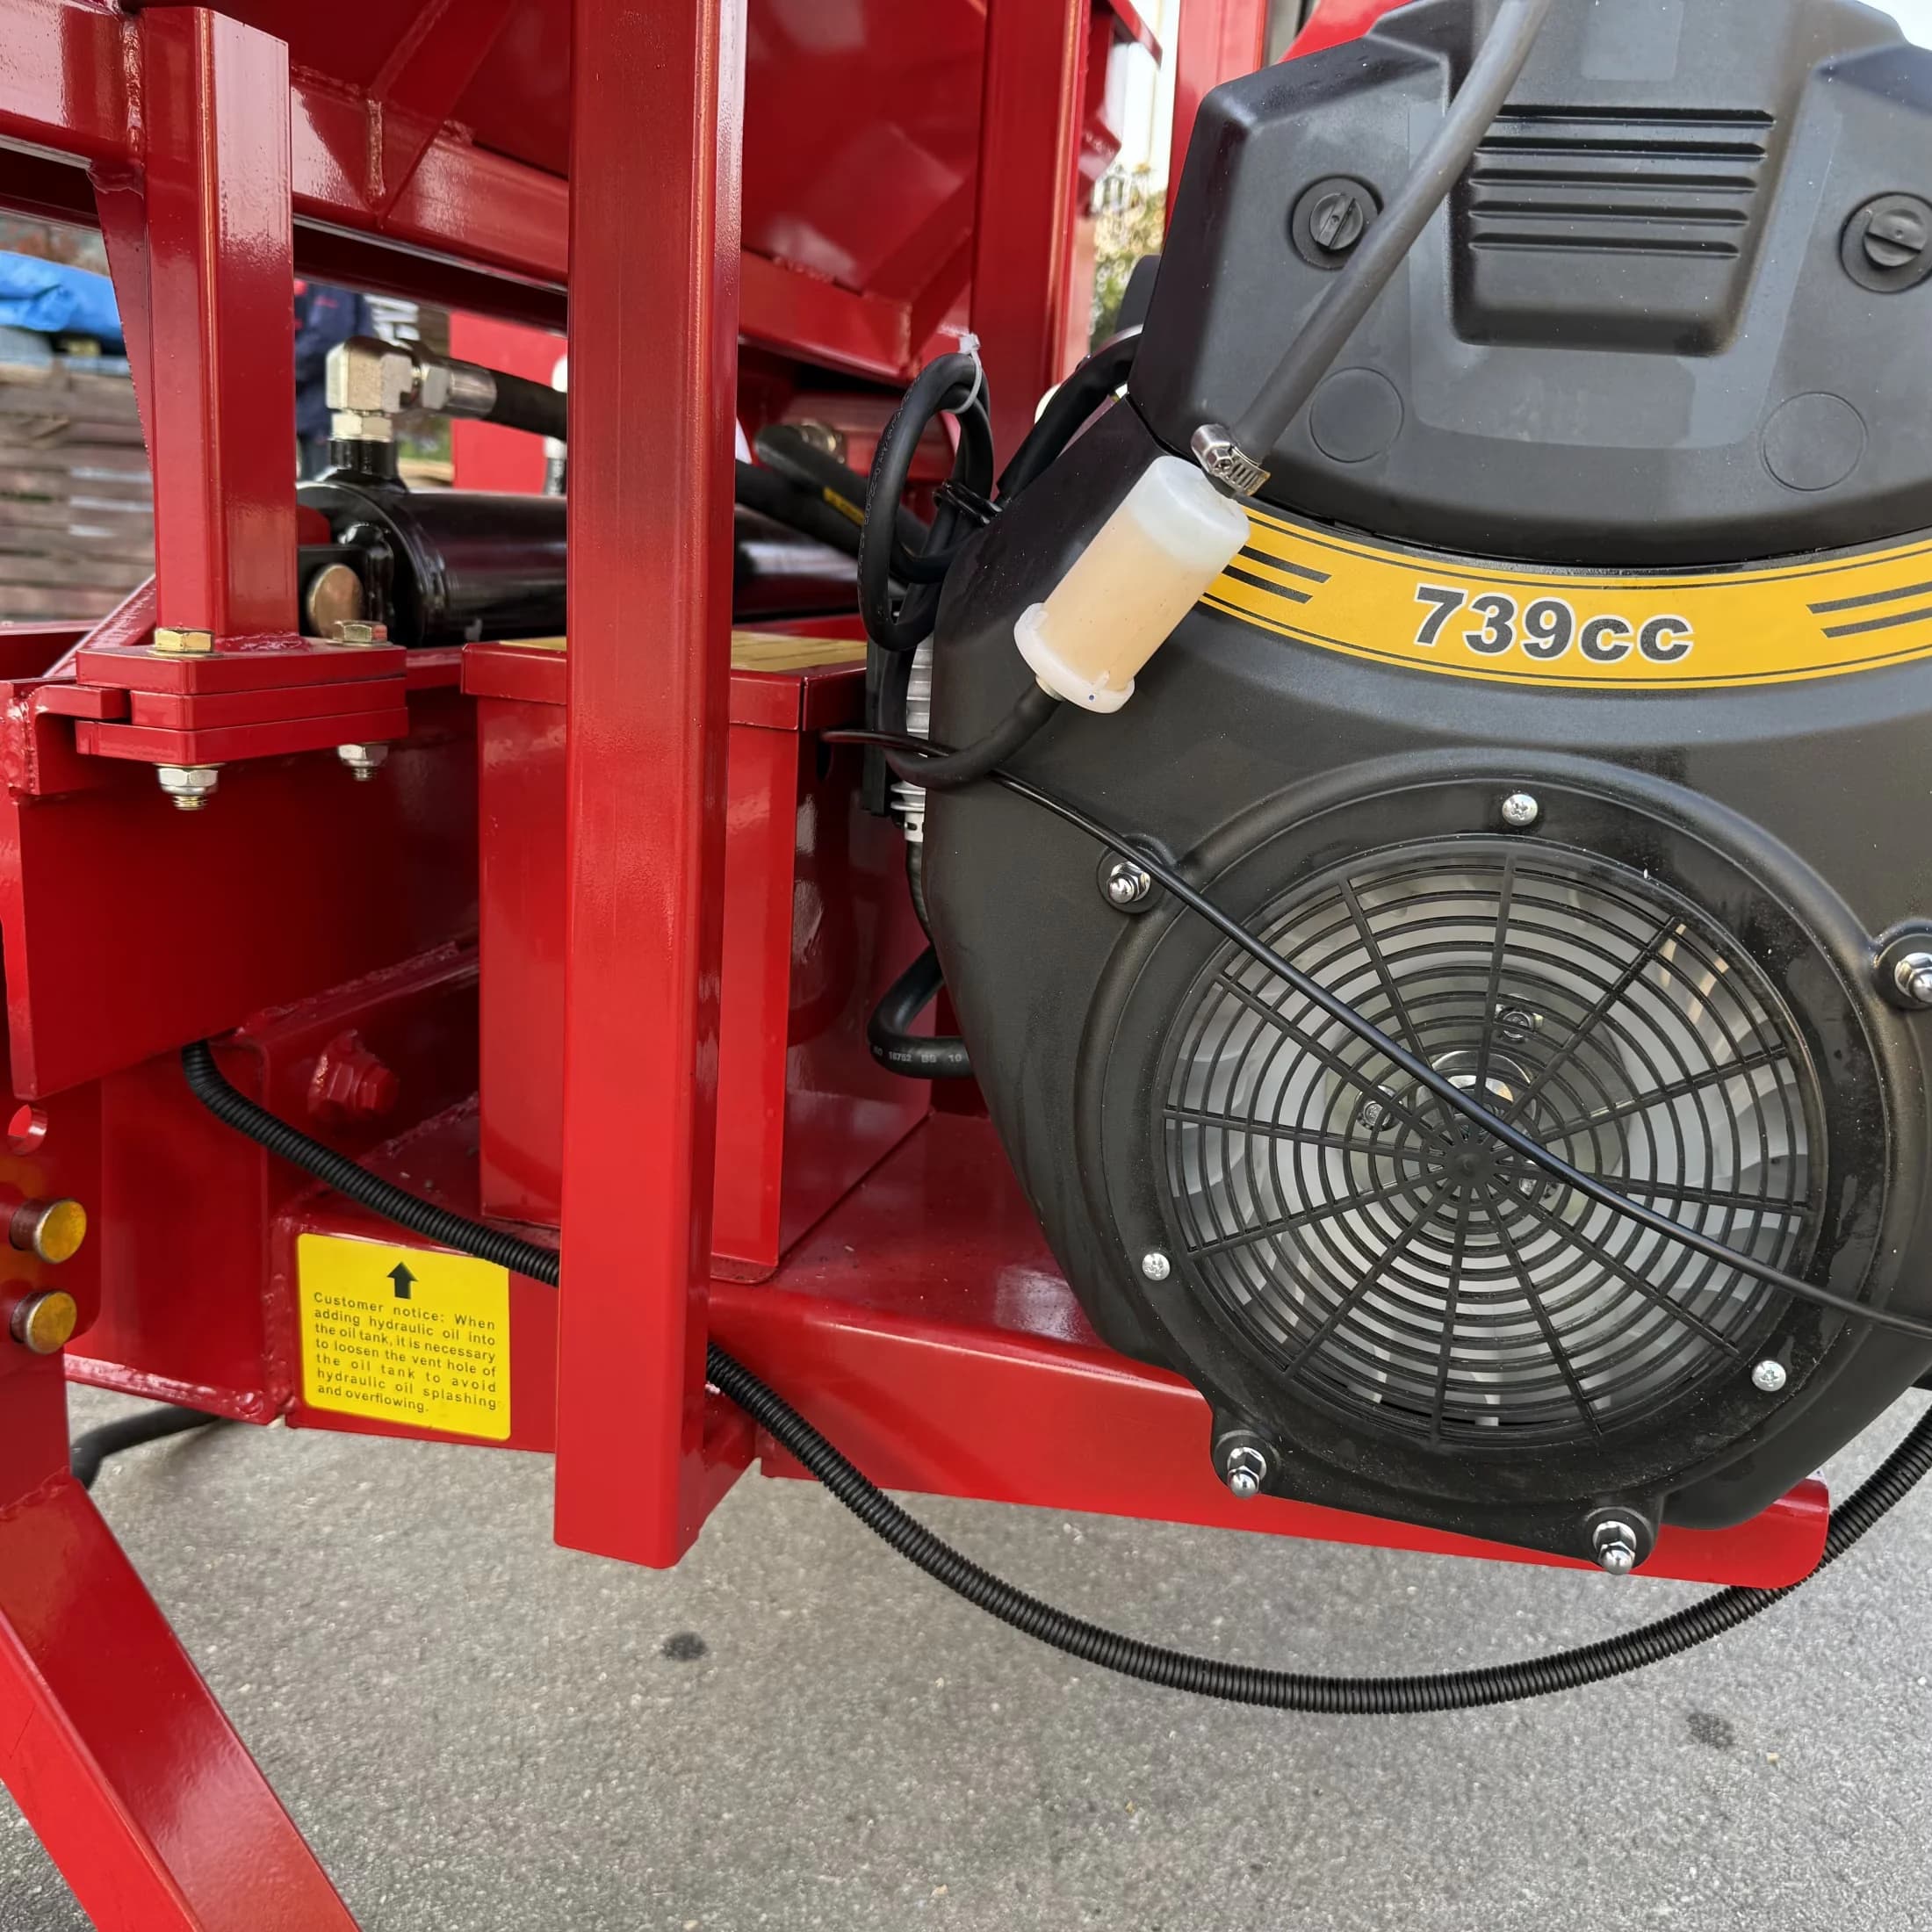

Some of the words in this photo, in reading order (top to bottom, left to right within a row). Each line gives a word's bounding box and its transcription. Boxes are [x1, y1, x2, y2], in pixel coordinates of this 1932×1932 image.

[1414, 583, 1694, 664] 739cc
[314, 1292, 383, 1313] Customer
[393, 1306, 444, 1323] notice:
[454, 1314, 494, 1330] When
[314, 1309, 360, 1327] adding
[370, 1316, 434, 1336] hydraulic
[443, 1328, 459, 1340] oil
[469, 1332, 495, 1346] into
[315, 1323, 335, 1336] the
[340, 1328, 356, 1338] oil
[359, 1330, 393, 1346] tank,
[396, 1336, 406, 1346] it
[409, 1337, 420, 1350] is
[425, 1342, 495, 1363] necessary
[316, 1338, 328, 1349] to
[334, 1340, 378, 1358] loosen
[386, 1350, 406, 1362] the
[412, 1355, 442, 1368] vent
[448, 1359, 476, 1373] hole
[483, 1366, 496, 1377] of
[316, 1353, 341, 1366] the
[351, 1360, 371, 1371] oil
[381, 1365, 415, 1380] tank
[427, 1370, 440, 1384] to
[451, 1377, 495, 1393] avoid
[317, 1367, 386, 1389] hydraulic
[395, 1382, 413, 1395] oil
[423, 1387, 496, 1410] splashing
[318, 1384, 342, 1397] and
[345, 1389, 429, 1413] overflowing.
